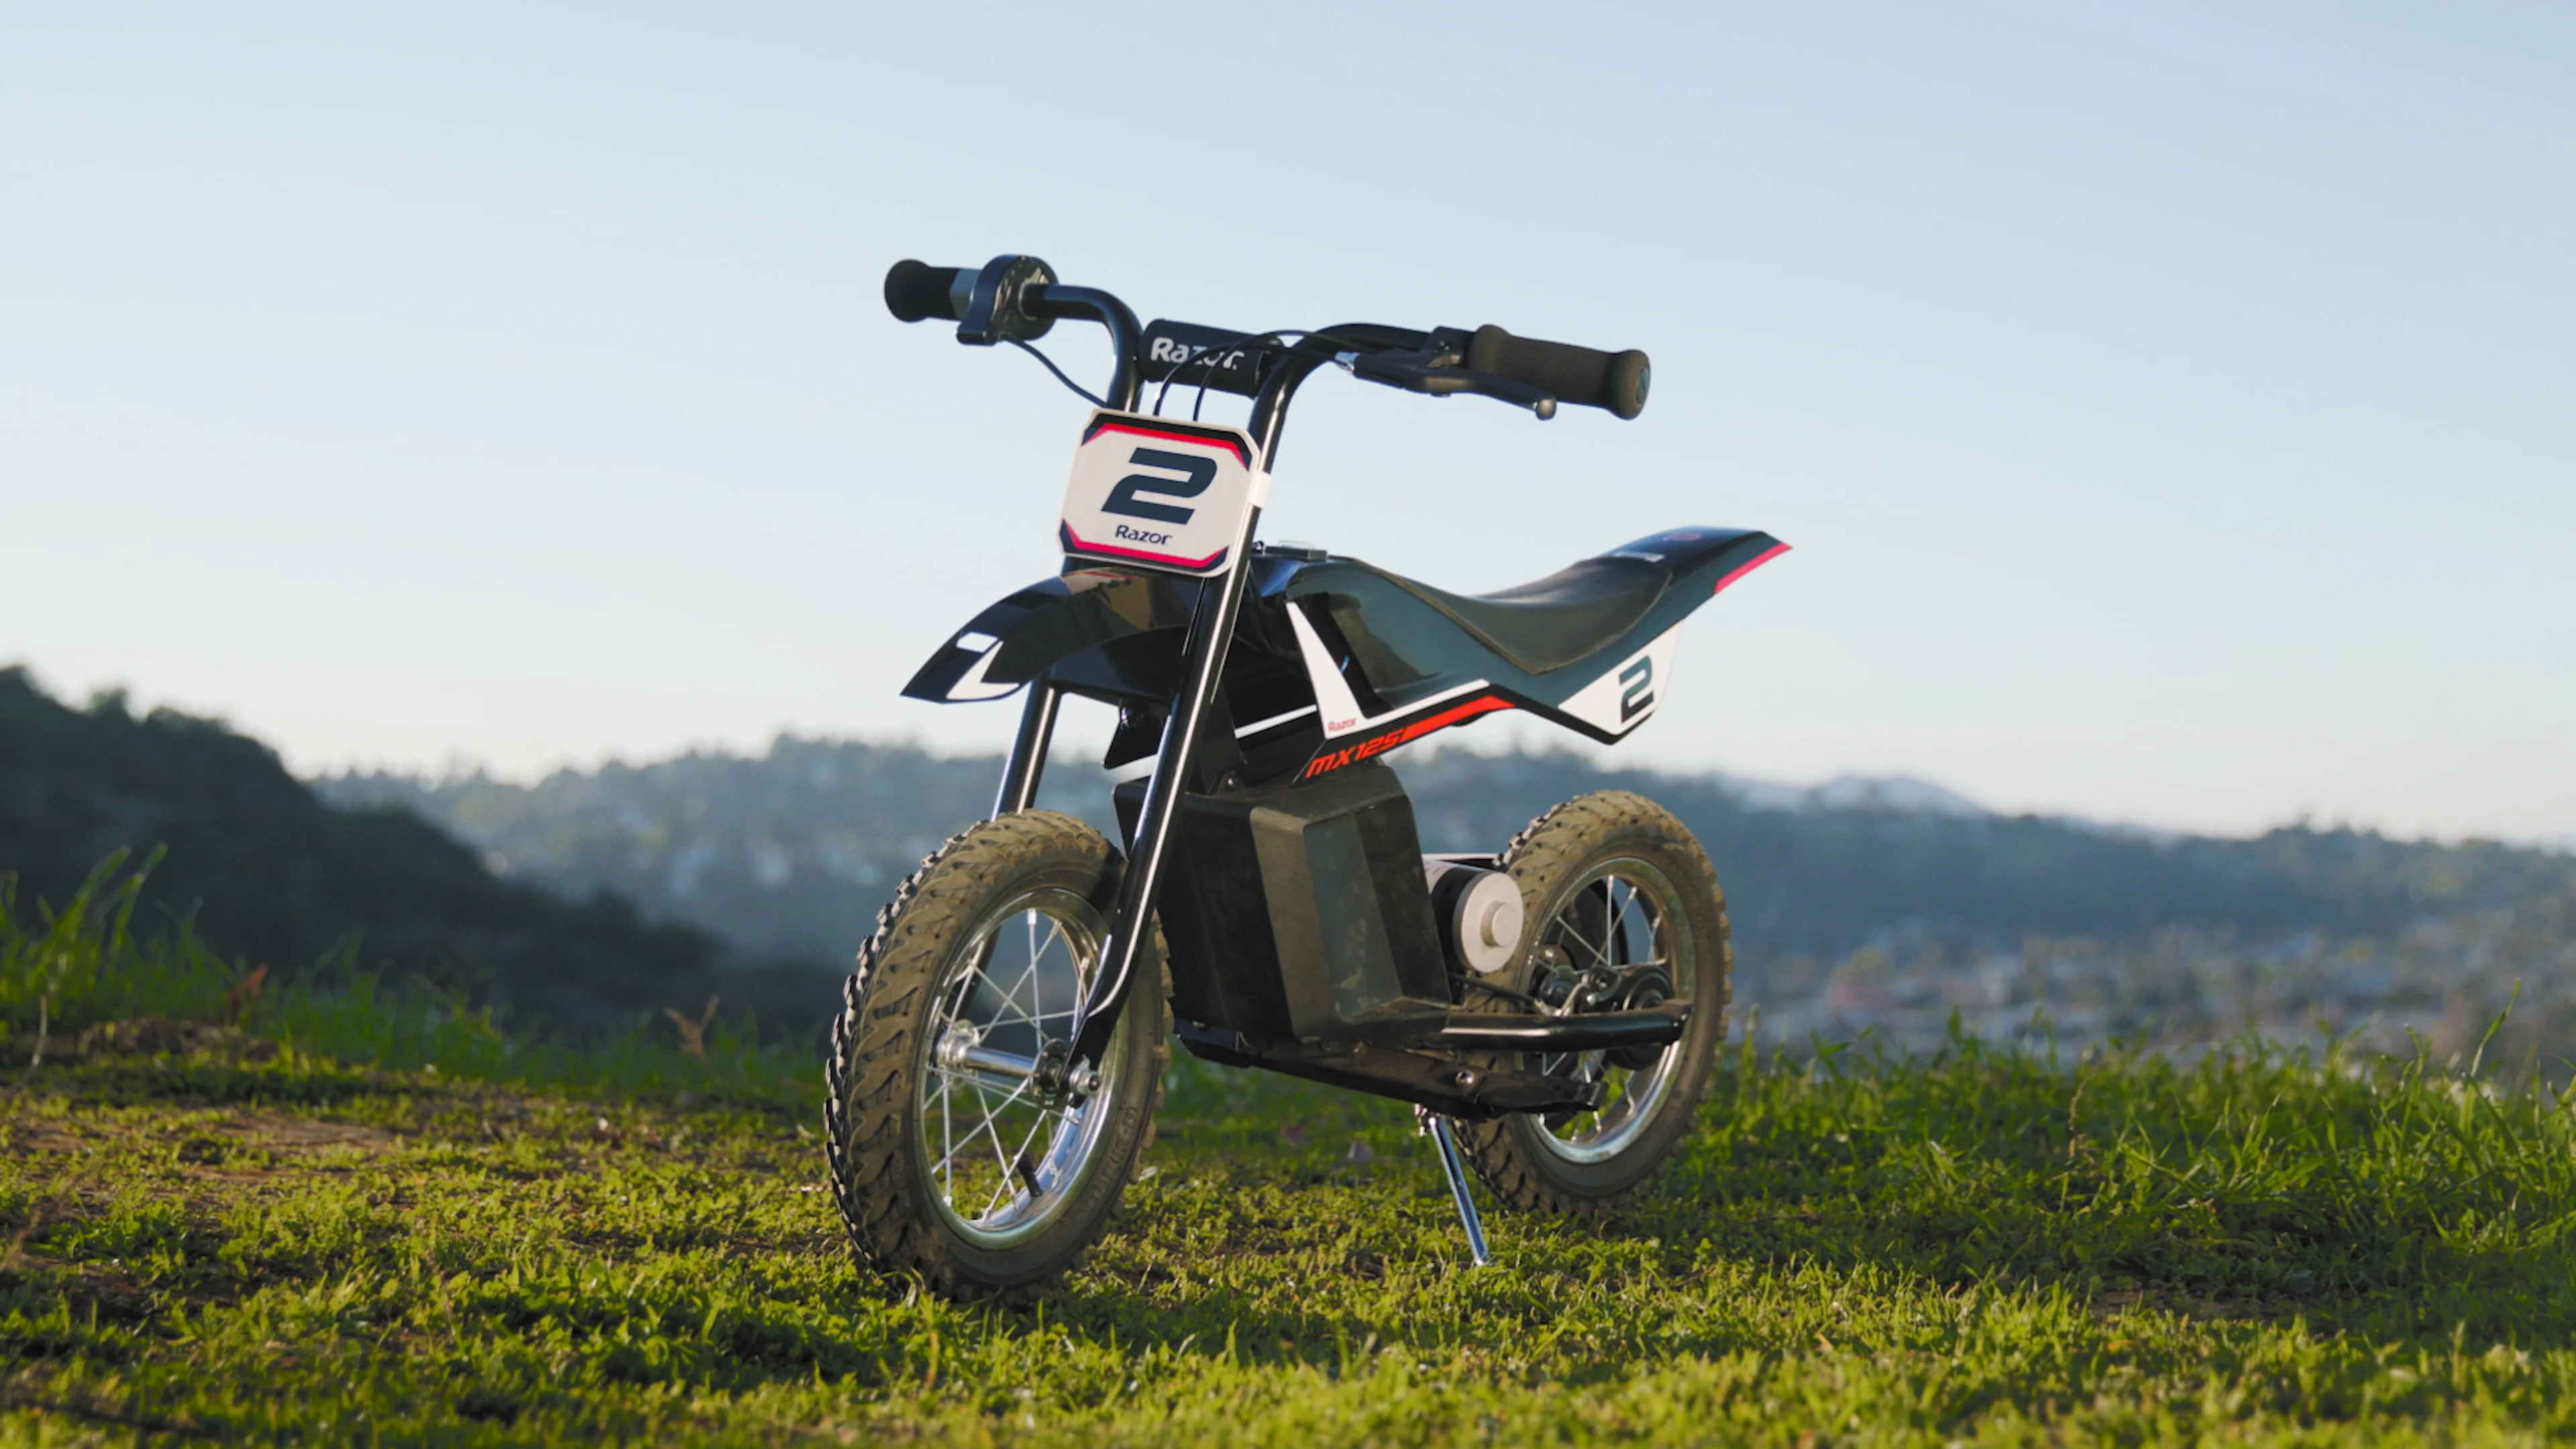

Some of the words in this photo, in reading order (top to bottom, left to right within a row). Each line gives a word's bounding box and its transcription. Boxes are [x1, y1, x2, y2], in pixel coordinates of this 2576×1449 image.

[1101, 447, 1218, 525] 2
[1115, 525, 1173, 545] Razor
[1619, 655, 1654, 724] 2
[1328, 718, 1357, 733] Razor
[1304, 727, 1406, 779] MX125
